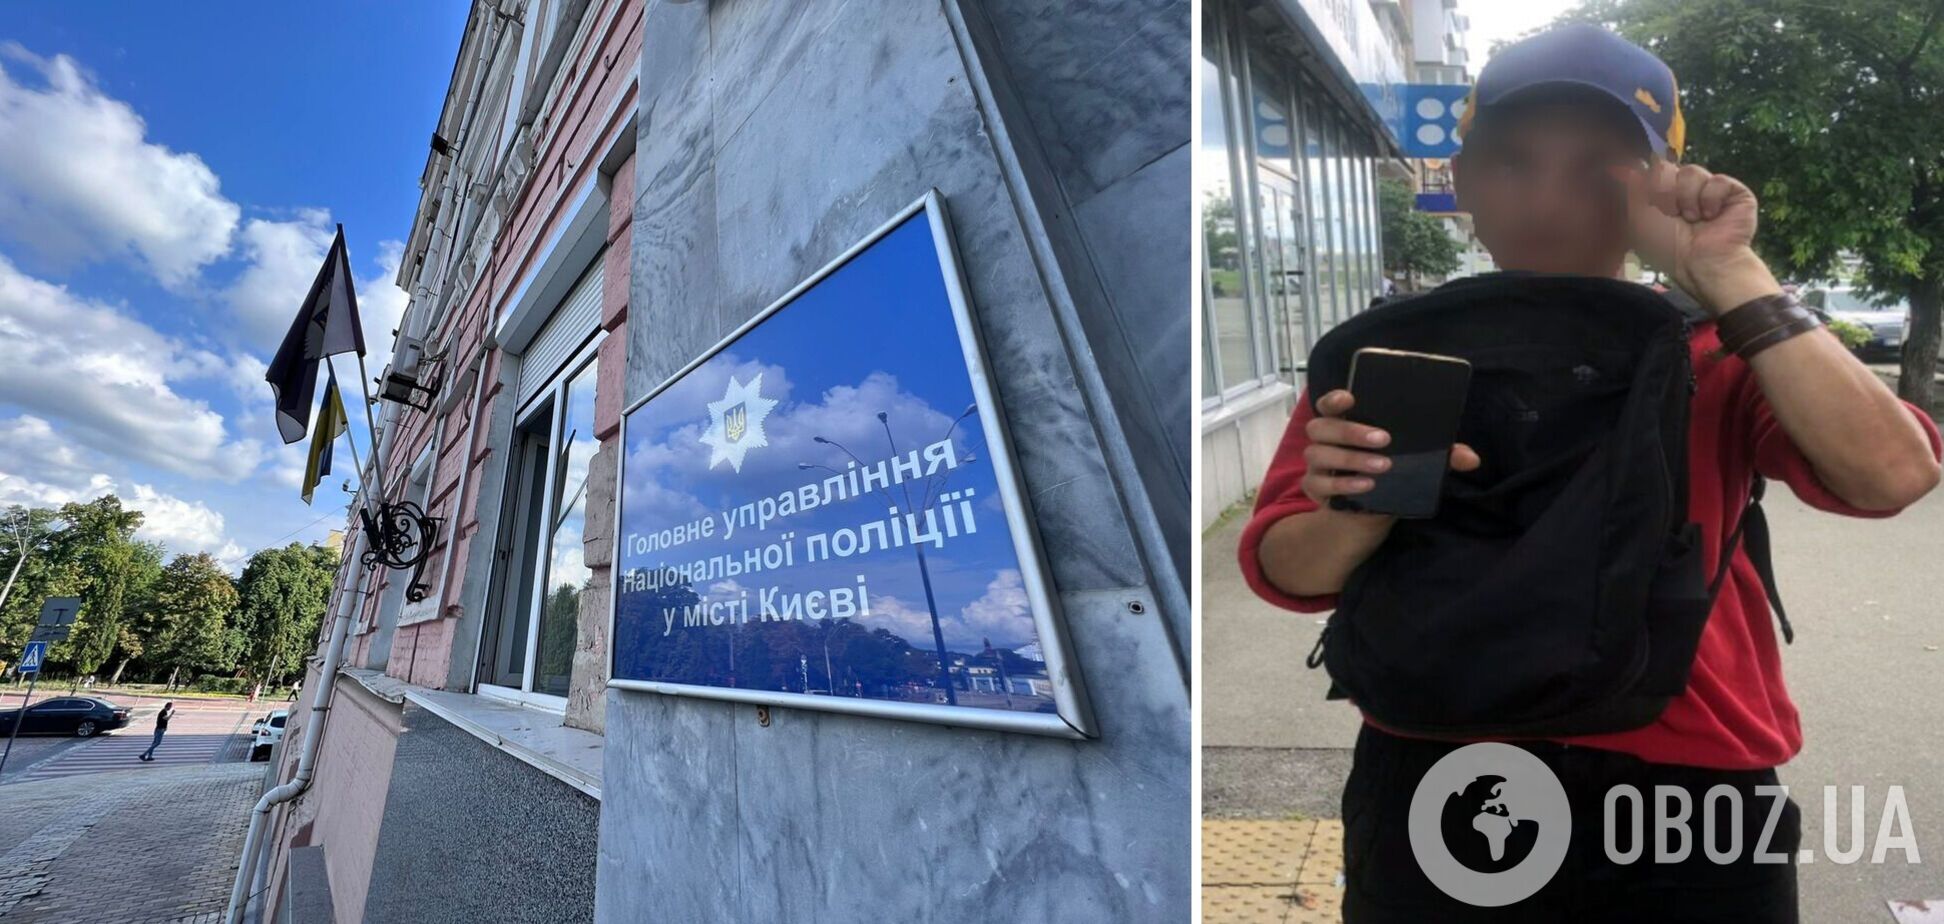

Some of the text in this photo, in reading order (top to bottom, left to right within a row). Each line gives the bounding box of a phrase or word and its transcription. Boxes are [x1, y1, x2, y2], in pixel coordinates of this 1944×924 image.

[622, 488, 977, 594] Національної поліції
[627, 439, 958, 557] Головне управління
[663, 574, 871, 637] у місті Києві
